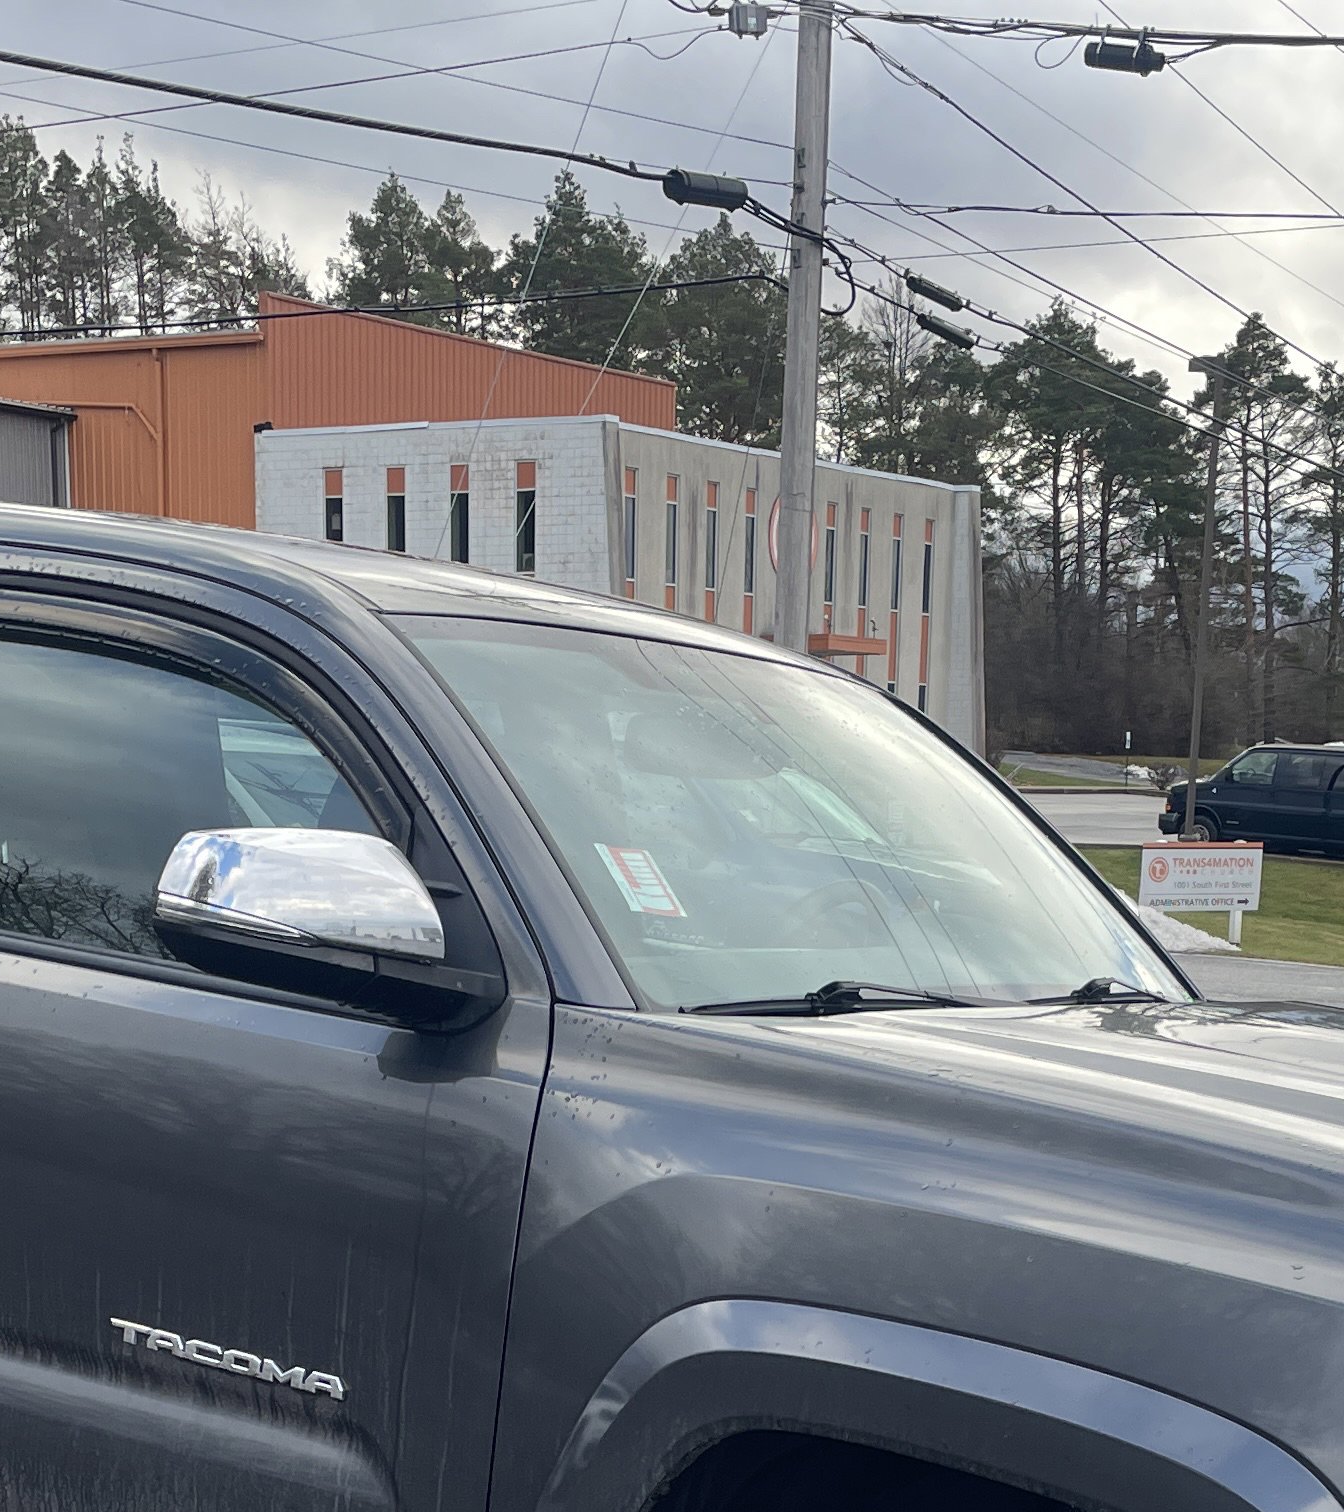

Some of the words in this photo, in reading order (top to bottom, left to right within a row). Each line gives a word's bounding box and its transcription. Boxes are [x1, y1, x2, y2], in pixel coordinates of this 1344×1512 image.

[1172, 857, 1254, 868] TRANS4MATION
[1192, 881, 1212, 889] South
[1232, 881, 1253, 889] Street
[1211, 898, 1234, 906] OFFICE
[110, 1317, 344, 1401] TACOMA
